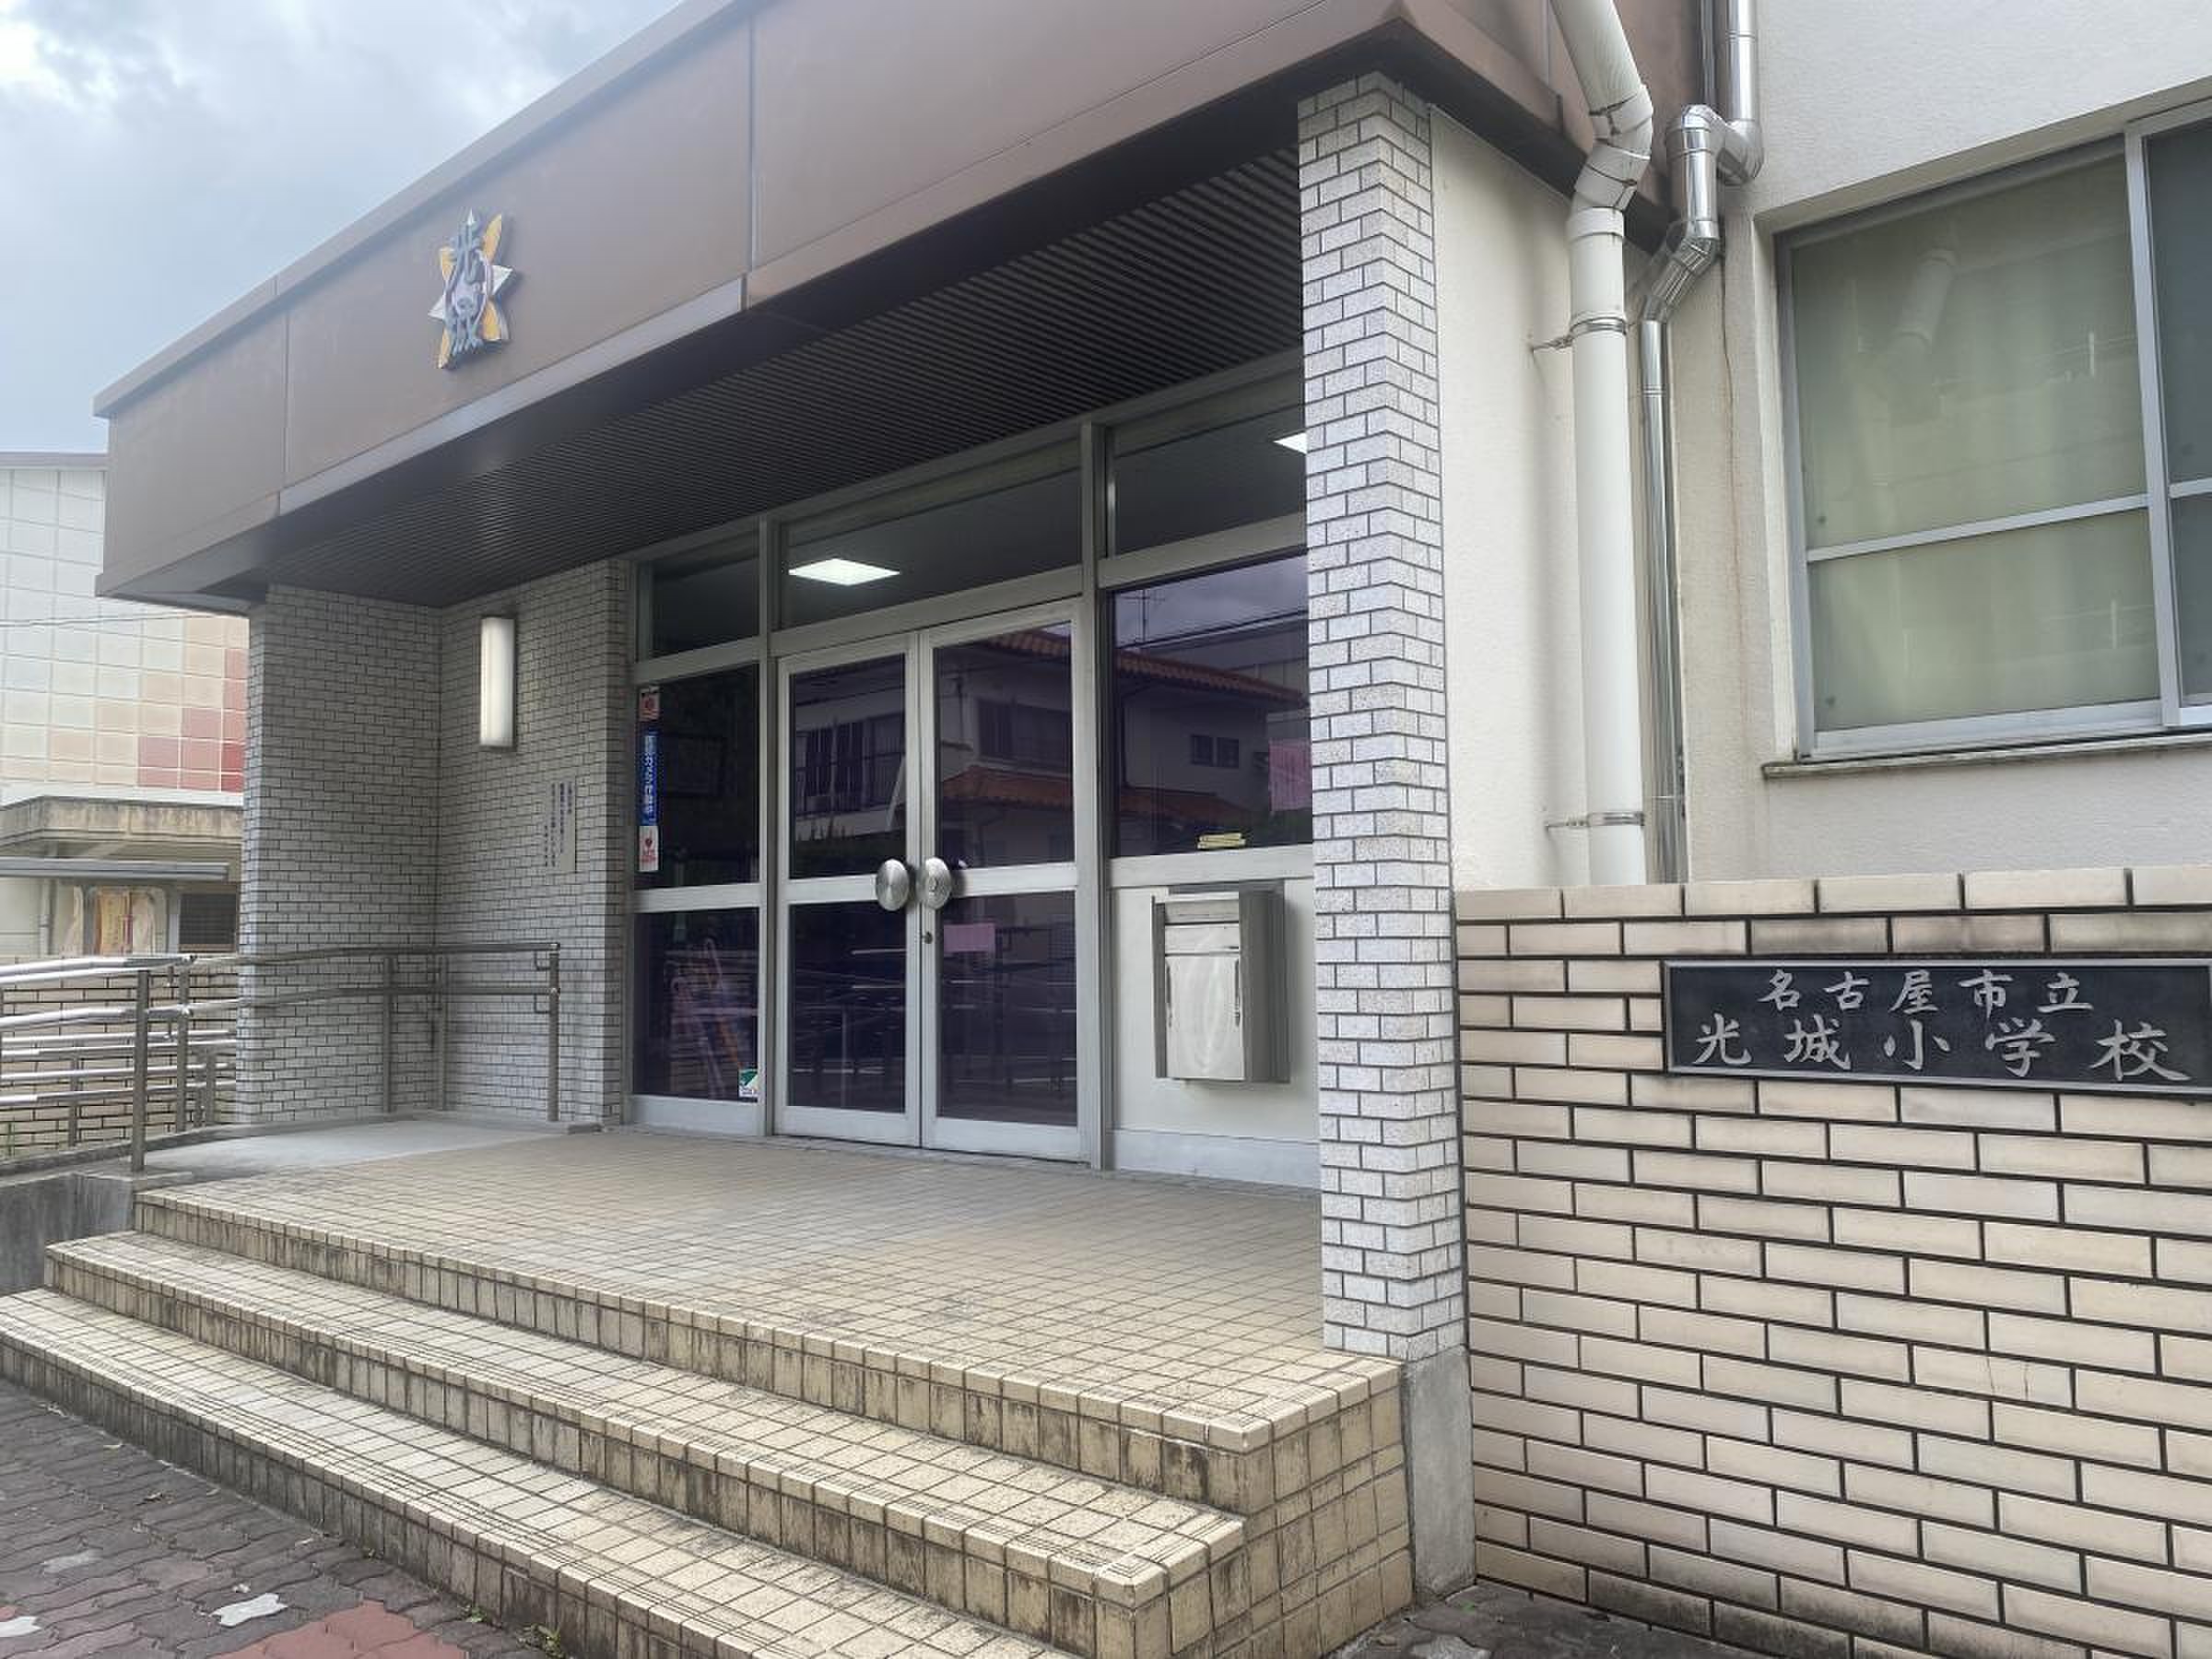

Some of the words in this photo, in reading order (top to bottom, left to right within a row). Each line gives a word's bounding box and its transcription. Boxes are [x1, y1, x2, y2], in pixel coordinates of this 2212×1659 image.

[1758, 969, 2094, 1018] 名古屋市立
[1693, 1012, 2192, 1082] 光城小学校
